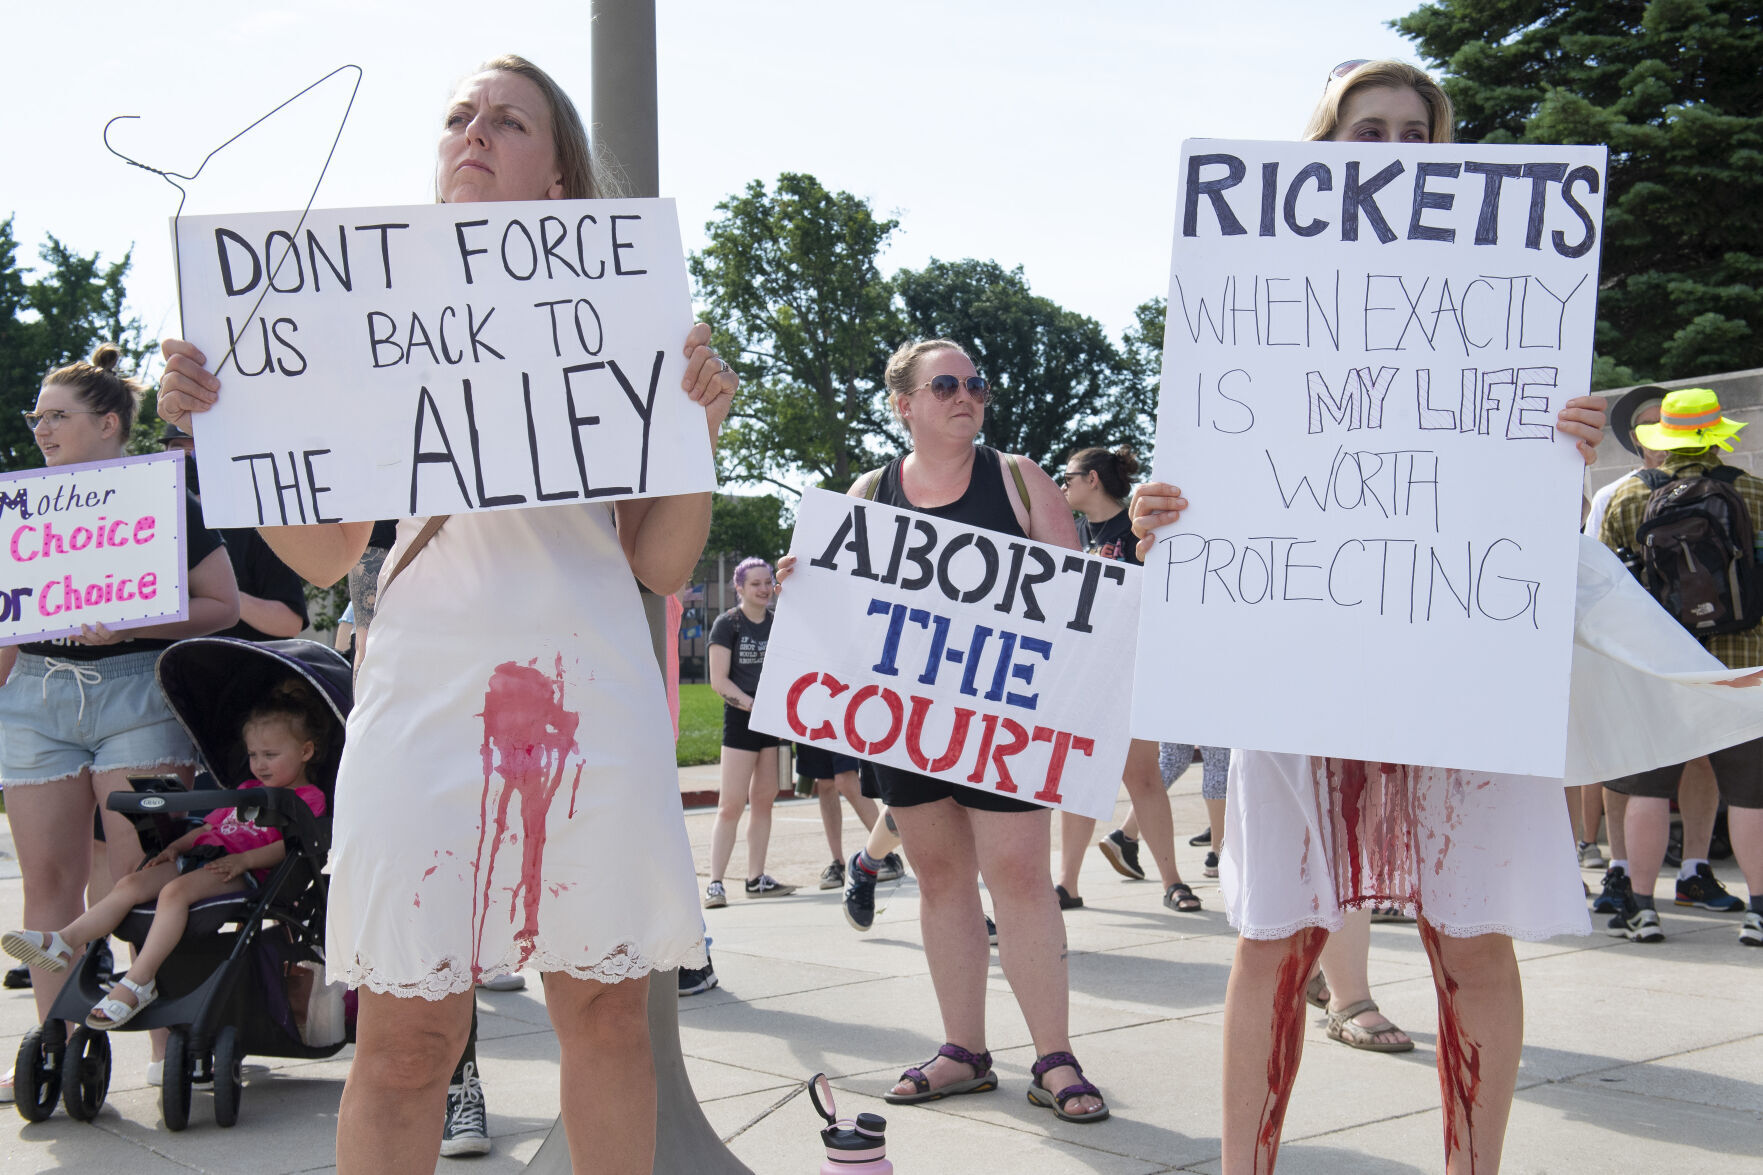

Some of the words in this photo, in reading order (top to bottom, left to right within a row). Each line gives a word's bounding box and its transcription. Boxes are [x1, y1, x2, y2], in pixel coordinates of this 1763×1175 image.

[1182, 153, 1599, 258] RICKETTS
[215, 223, 409, 297] DONT
[455, 215, 647, 284] FORCE
[226, 316, 307, 377] US
[367, 303, 505, 368] BACK
[534, 298, 603, 357] TO
[1175, 269, 1339, 351] WHEN
[1364, 273, 1588, 356] EXACTLY
[231, 449, 343, 525] THE
[410, 351, 665, 516] ALLEY
[1197, 368, 1254, 434] IS
[1306, 366, 1399, 435] MY
[1416, 366, 1558, 442] LIFE
[0, 484, 116, 520] Mother
[1266, 444, 1439, 533] WORTH
[10, 515, 156, 562] Choice
[810, 505, 1125, 633] ABORT
[1159, 533, 1540, 629] PROTECTING
[38, 572, 157, 616] Choice
[867, 598, 1052, 710] THE
[786, 672, 1095, 804] COURT
